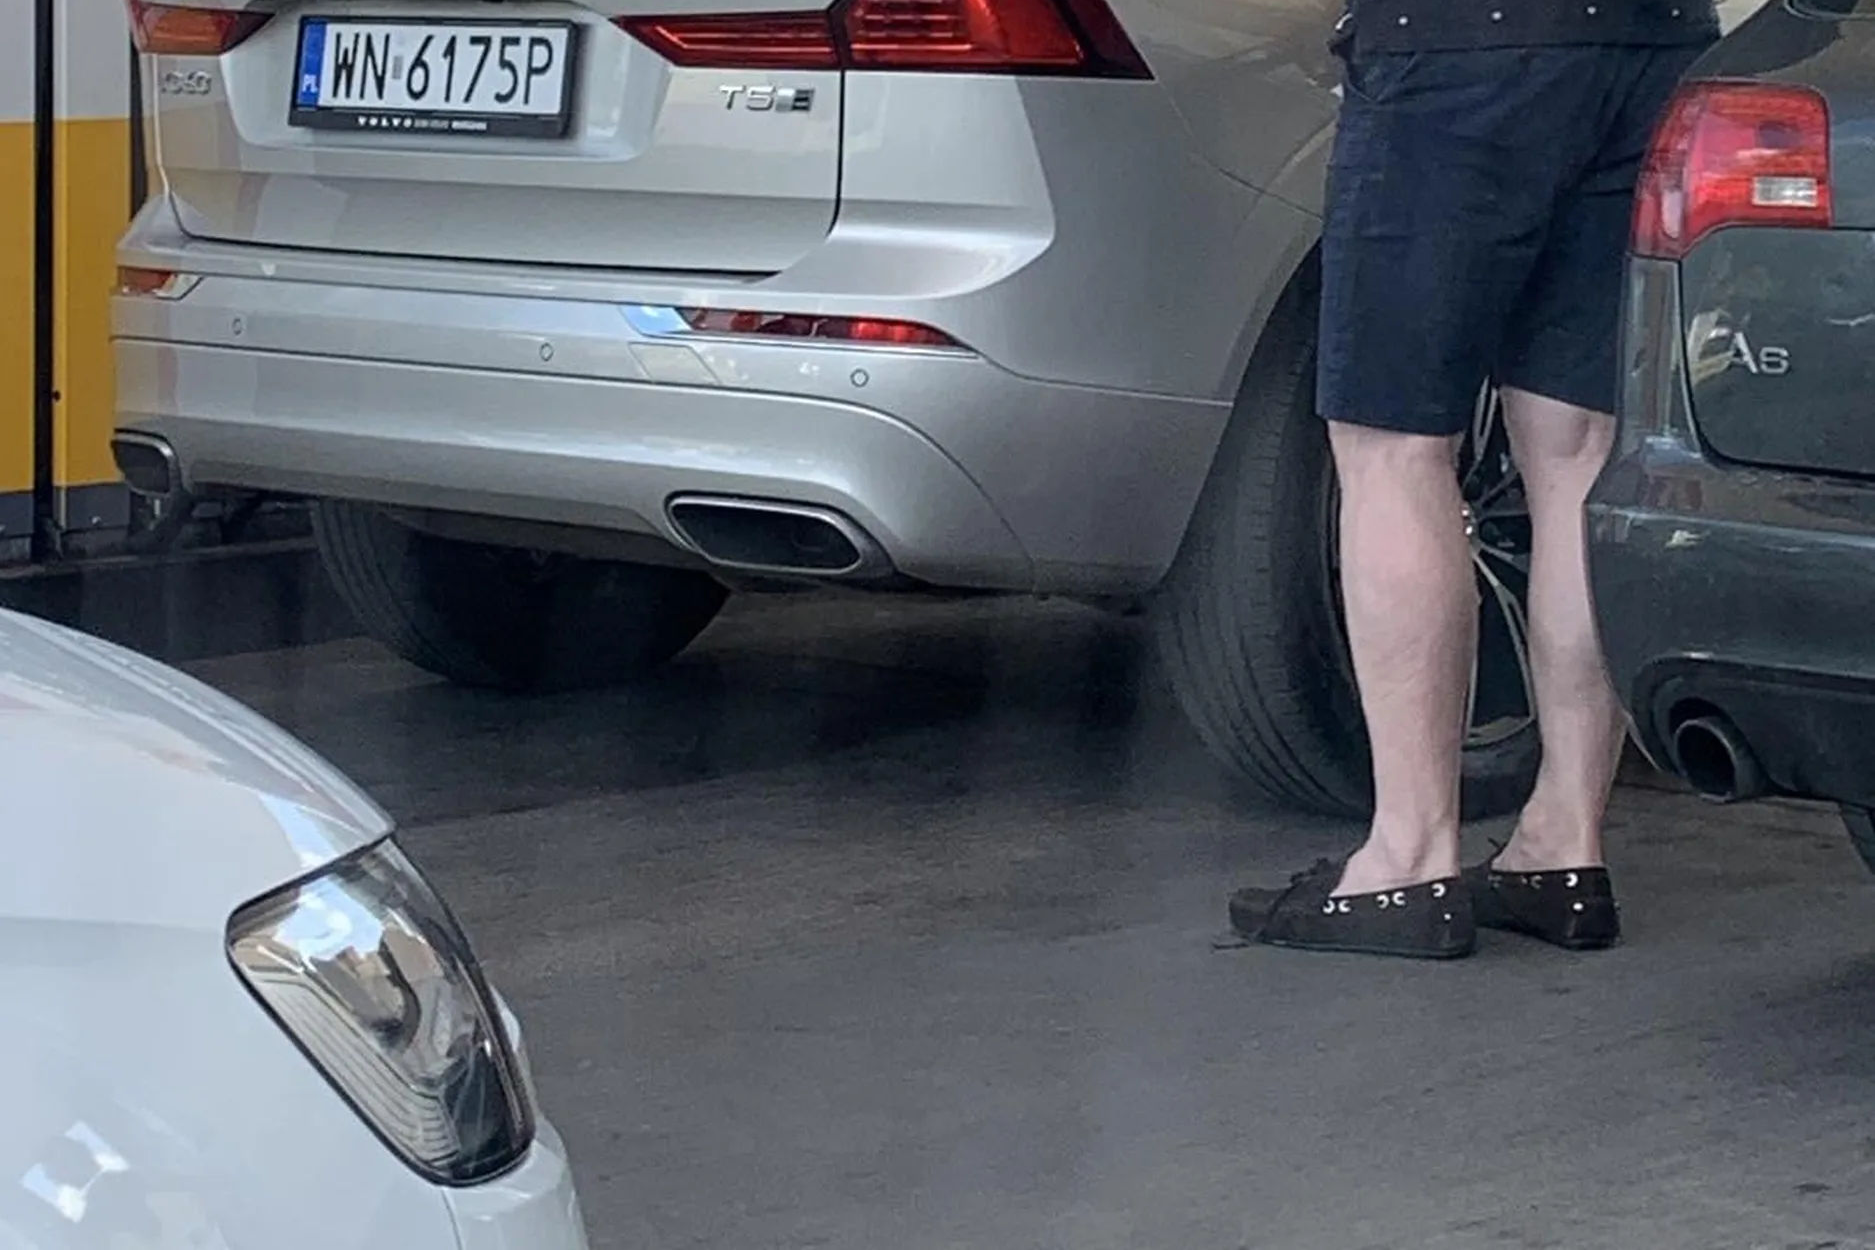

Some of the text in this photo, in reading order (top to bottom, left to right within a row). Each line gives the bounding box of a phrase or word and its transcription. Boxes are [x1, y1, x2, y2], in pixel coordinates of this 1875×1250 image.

[332, 32, 554, 105] WN 6175P
[303, 74, 318, 93] PL
[719, 85, 776, 111] T5
[358, 116, 413, 128] VOLVO
